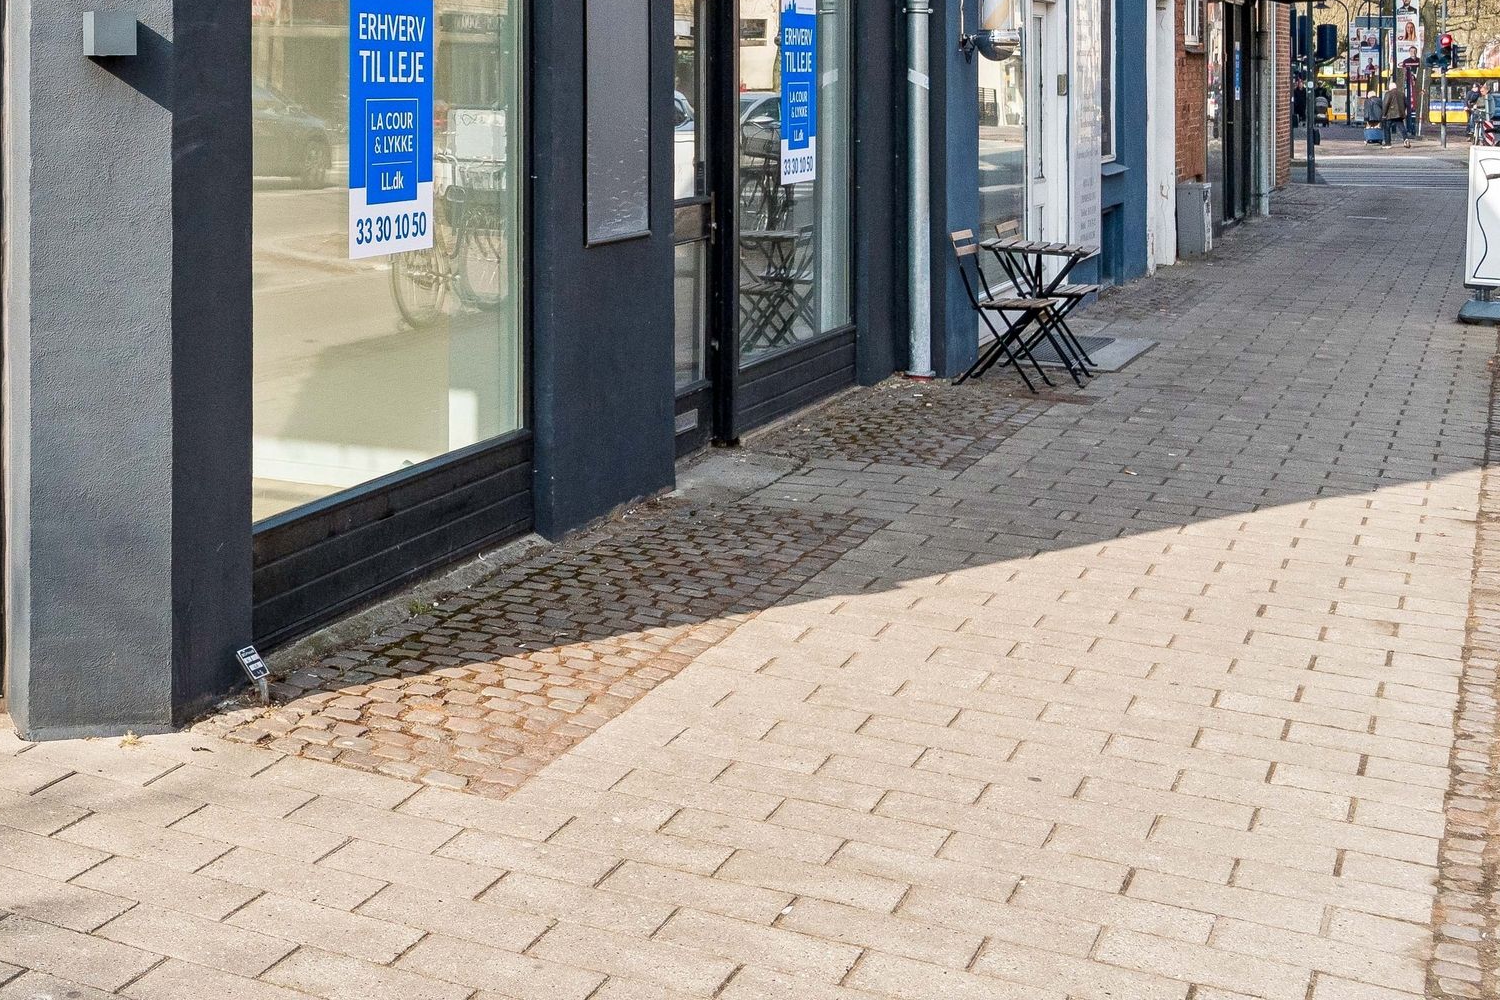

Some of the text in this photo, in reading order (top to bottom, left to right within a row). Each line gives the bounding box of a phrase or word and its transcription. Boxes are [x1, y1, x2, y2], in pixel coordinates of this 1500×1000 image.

[359, 13, 426, 42] ERHVERV
[784, 28, 813, 46] ERHVERV
[359, 50, 425, 83] TIL LEJE
[785, 51, 812, 73] TIL LEJE
[790, 91, 808, 103] LA COUR
[371, 112, 414, 130] LA COUR
[374, 134, 414, 154] & LYKKE
[783, 155, 813, 175] 33 30 10 50
[381, 170, 404, 191] LL.dk
[356, 211, 427, 245] 33 30 10 50
